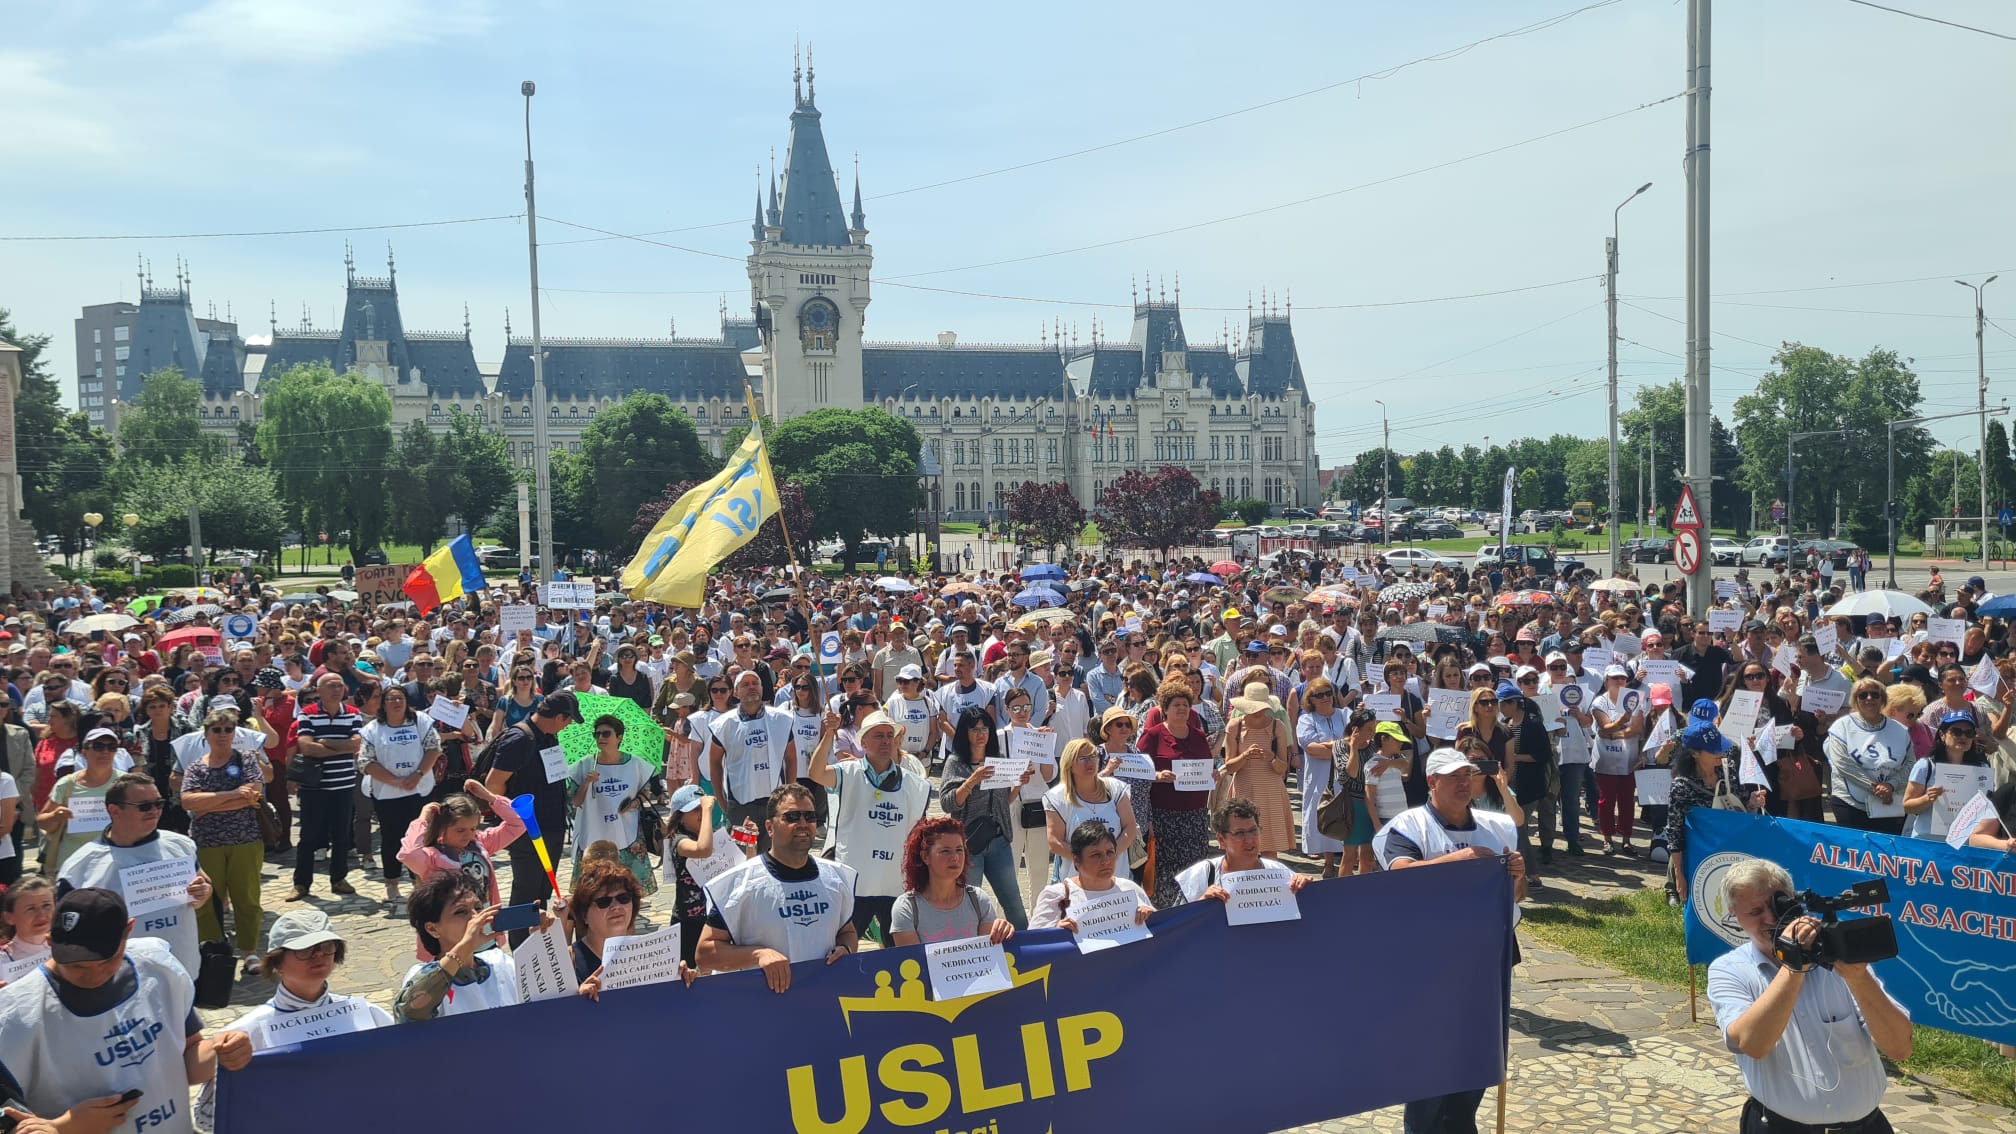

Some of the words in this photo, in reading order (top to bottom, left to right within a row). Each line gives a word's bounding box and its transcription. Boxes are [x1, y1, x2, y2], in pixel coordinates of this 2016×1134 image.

[389, 734, 418, 742] USLIP
[596, 784, 629, 794] USLIP
[868, 810, 904, 822] USLIP
[1236, 873, 1284, 883] PERSONALUL
[1951, 864, 2016, 897] SIN
[1235, 886, 1281, 896] NEDIDACTIC
[779, 902, 829, 918] USLIP
[1081, 895, 1131, 913] PERSONALUL
[1238, 898, 1282, 909] CONTEAZĂ!
[144, 915, 177, 932] FSLI
[1082, 910, 1129, 927] NEDIDACTIC
[1899, 900, 2016, 942] ASACHI
[1088, 923, 1131, 939] CONTEAZĂ!
[645, 936, 663, 948] ESTE
[664, 932, 678, 941] CEA
[611, 957, 626, 966] MAI
[628, 945, 671, 963] PUTERNICĂ
[941, 955, 991, 969] NEDIDACTIC
[532, 953, 548, 994] PENTRU
[605, 968, 628, 979] ARMĂ
[629, 963, 650, 973] CARE
[652, 957, 676, 968] POATE
[945, 967, 993, 982] CONTEAZĂ!
[606, 977, 642, 990] SCHIMBA
[643, 969, 673, 982] LUMEA!
[270, 1016, 302, 1032] DACĂ
[306, 1029, 322, 1038] NU
[94, 1022, 163, 1067] USLIP
[786, 1011, 1124, 1134] USLIP
[135, 1099, 176, 1134] FSLI
